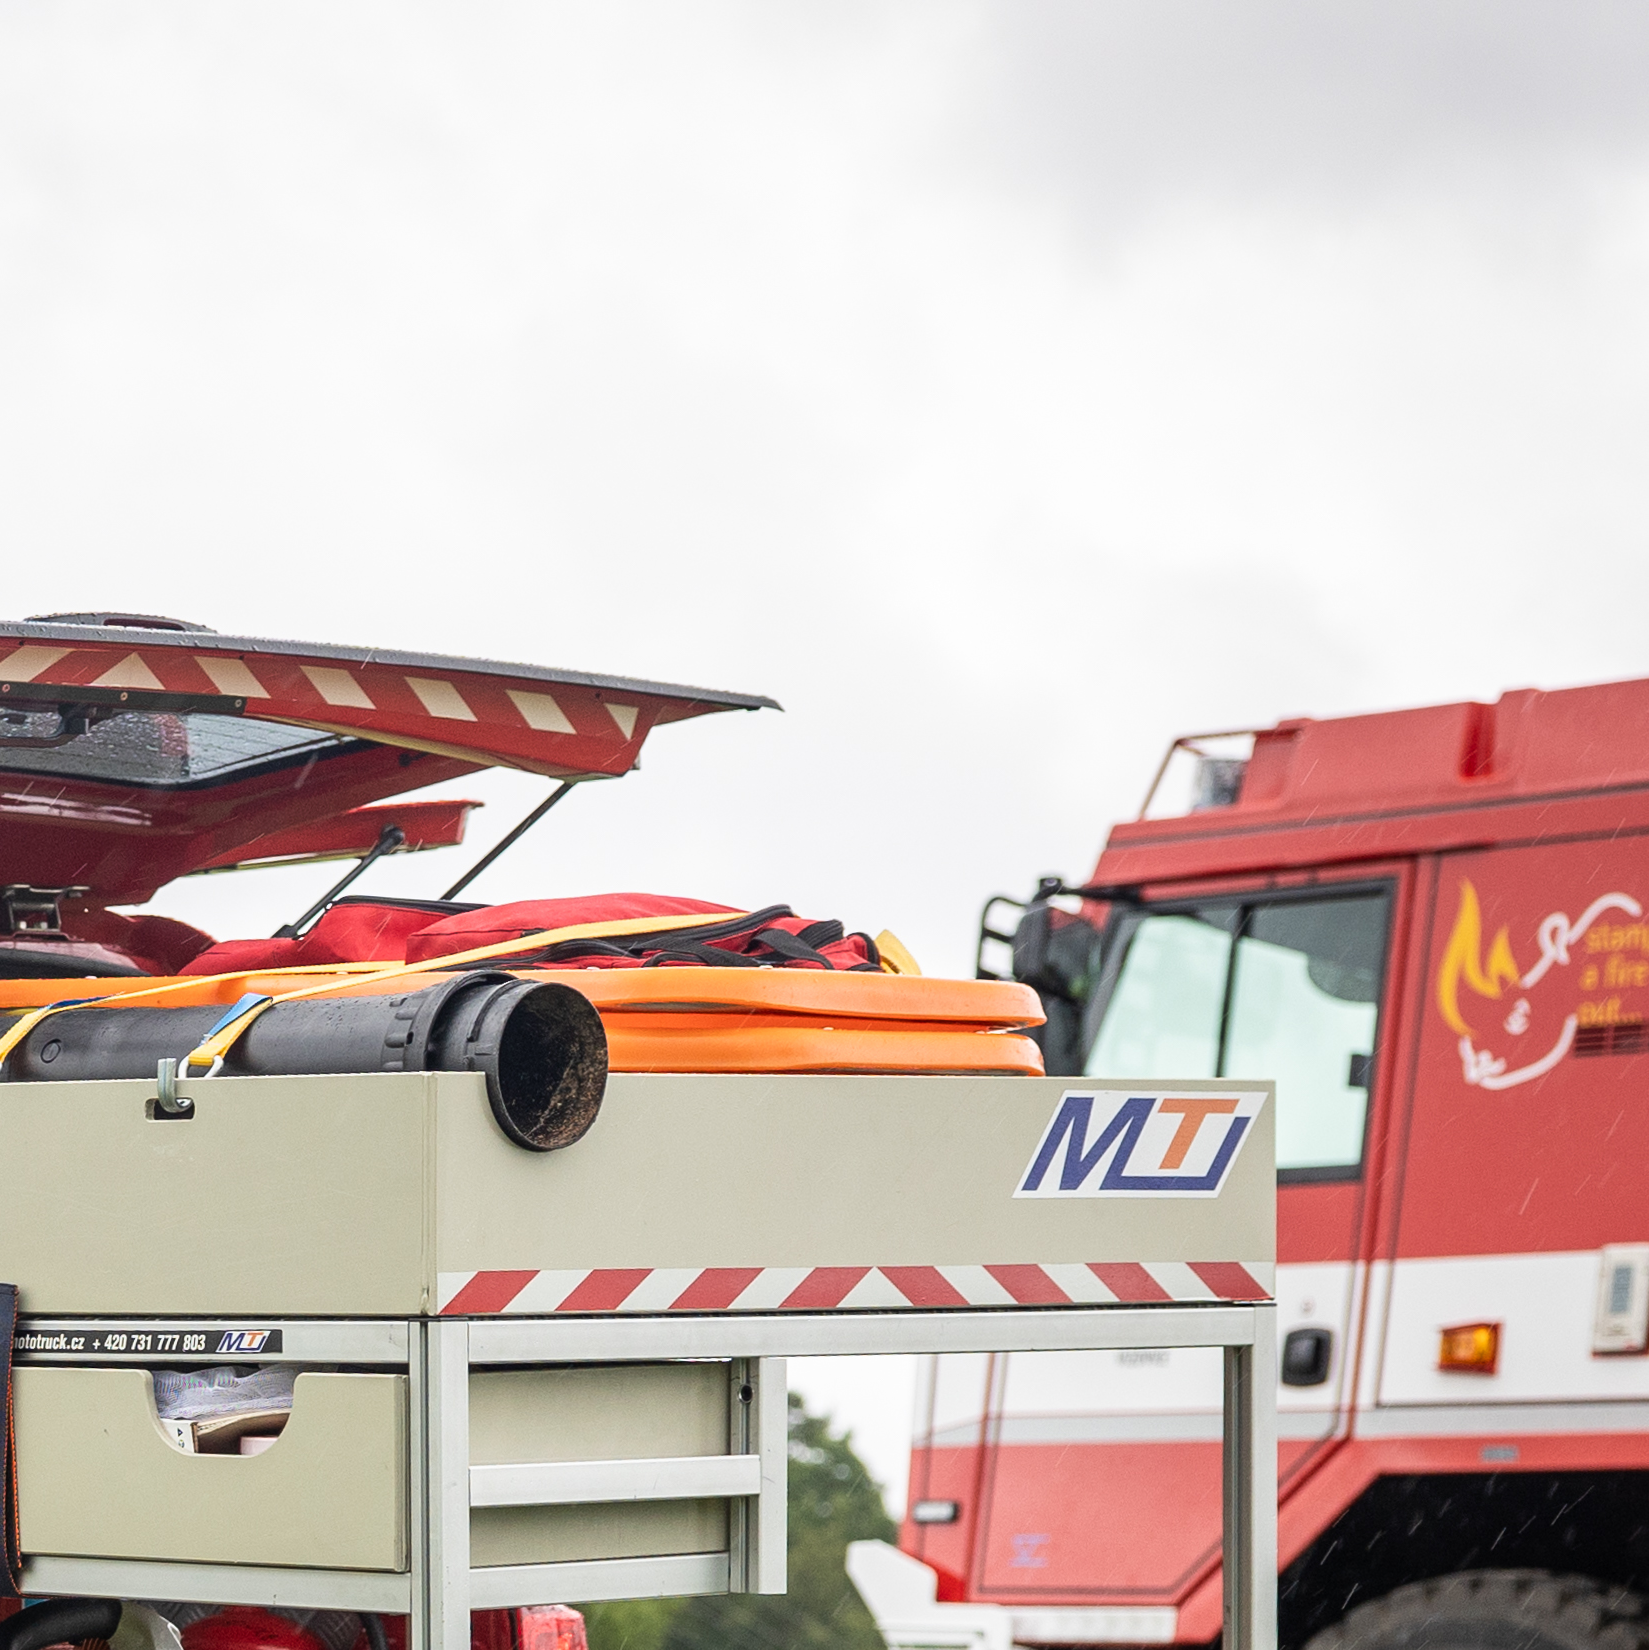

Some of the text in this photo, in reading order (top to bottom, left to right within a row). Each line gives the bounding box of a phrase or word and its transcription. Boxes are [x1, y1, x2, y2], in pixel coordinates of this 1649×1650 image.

[104, 1333, 128, 1350] 420
[131, 1333, 152, 1351] 731
[157, 1334, 180, 1351] 777
[183, 1334, 207, 1351] 803
